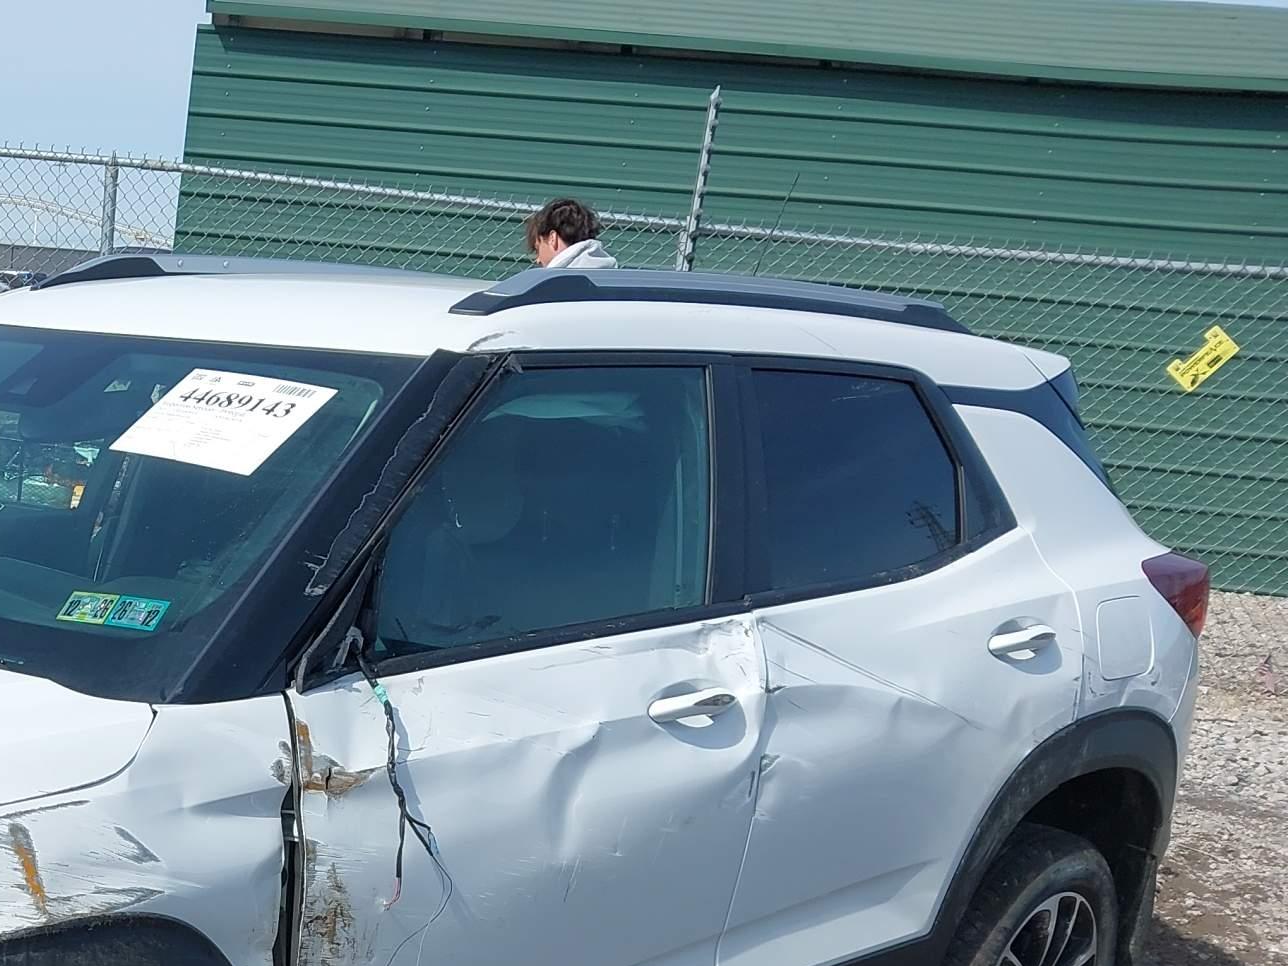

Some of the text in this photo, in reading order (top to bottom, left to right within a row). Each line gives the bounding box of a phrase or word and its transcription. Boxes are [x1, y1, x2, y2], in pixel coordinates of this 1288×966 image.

[180, 388, 296, 418] 44689143
[63, 599, 81, 617] 12
[111, 600, 160, 627] 26 12
